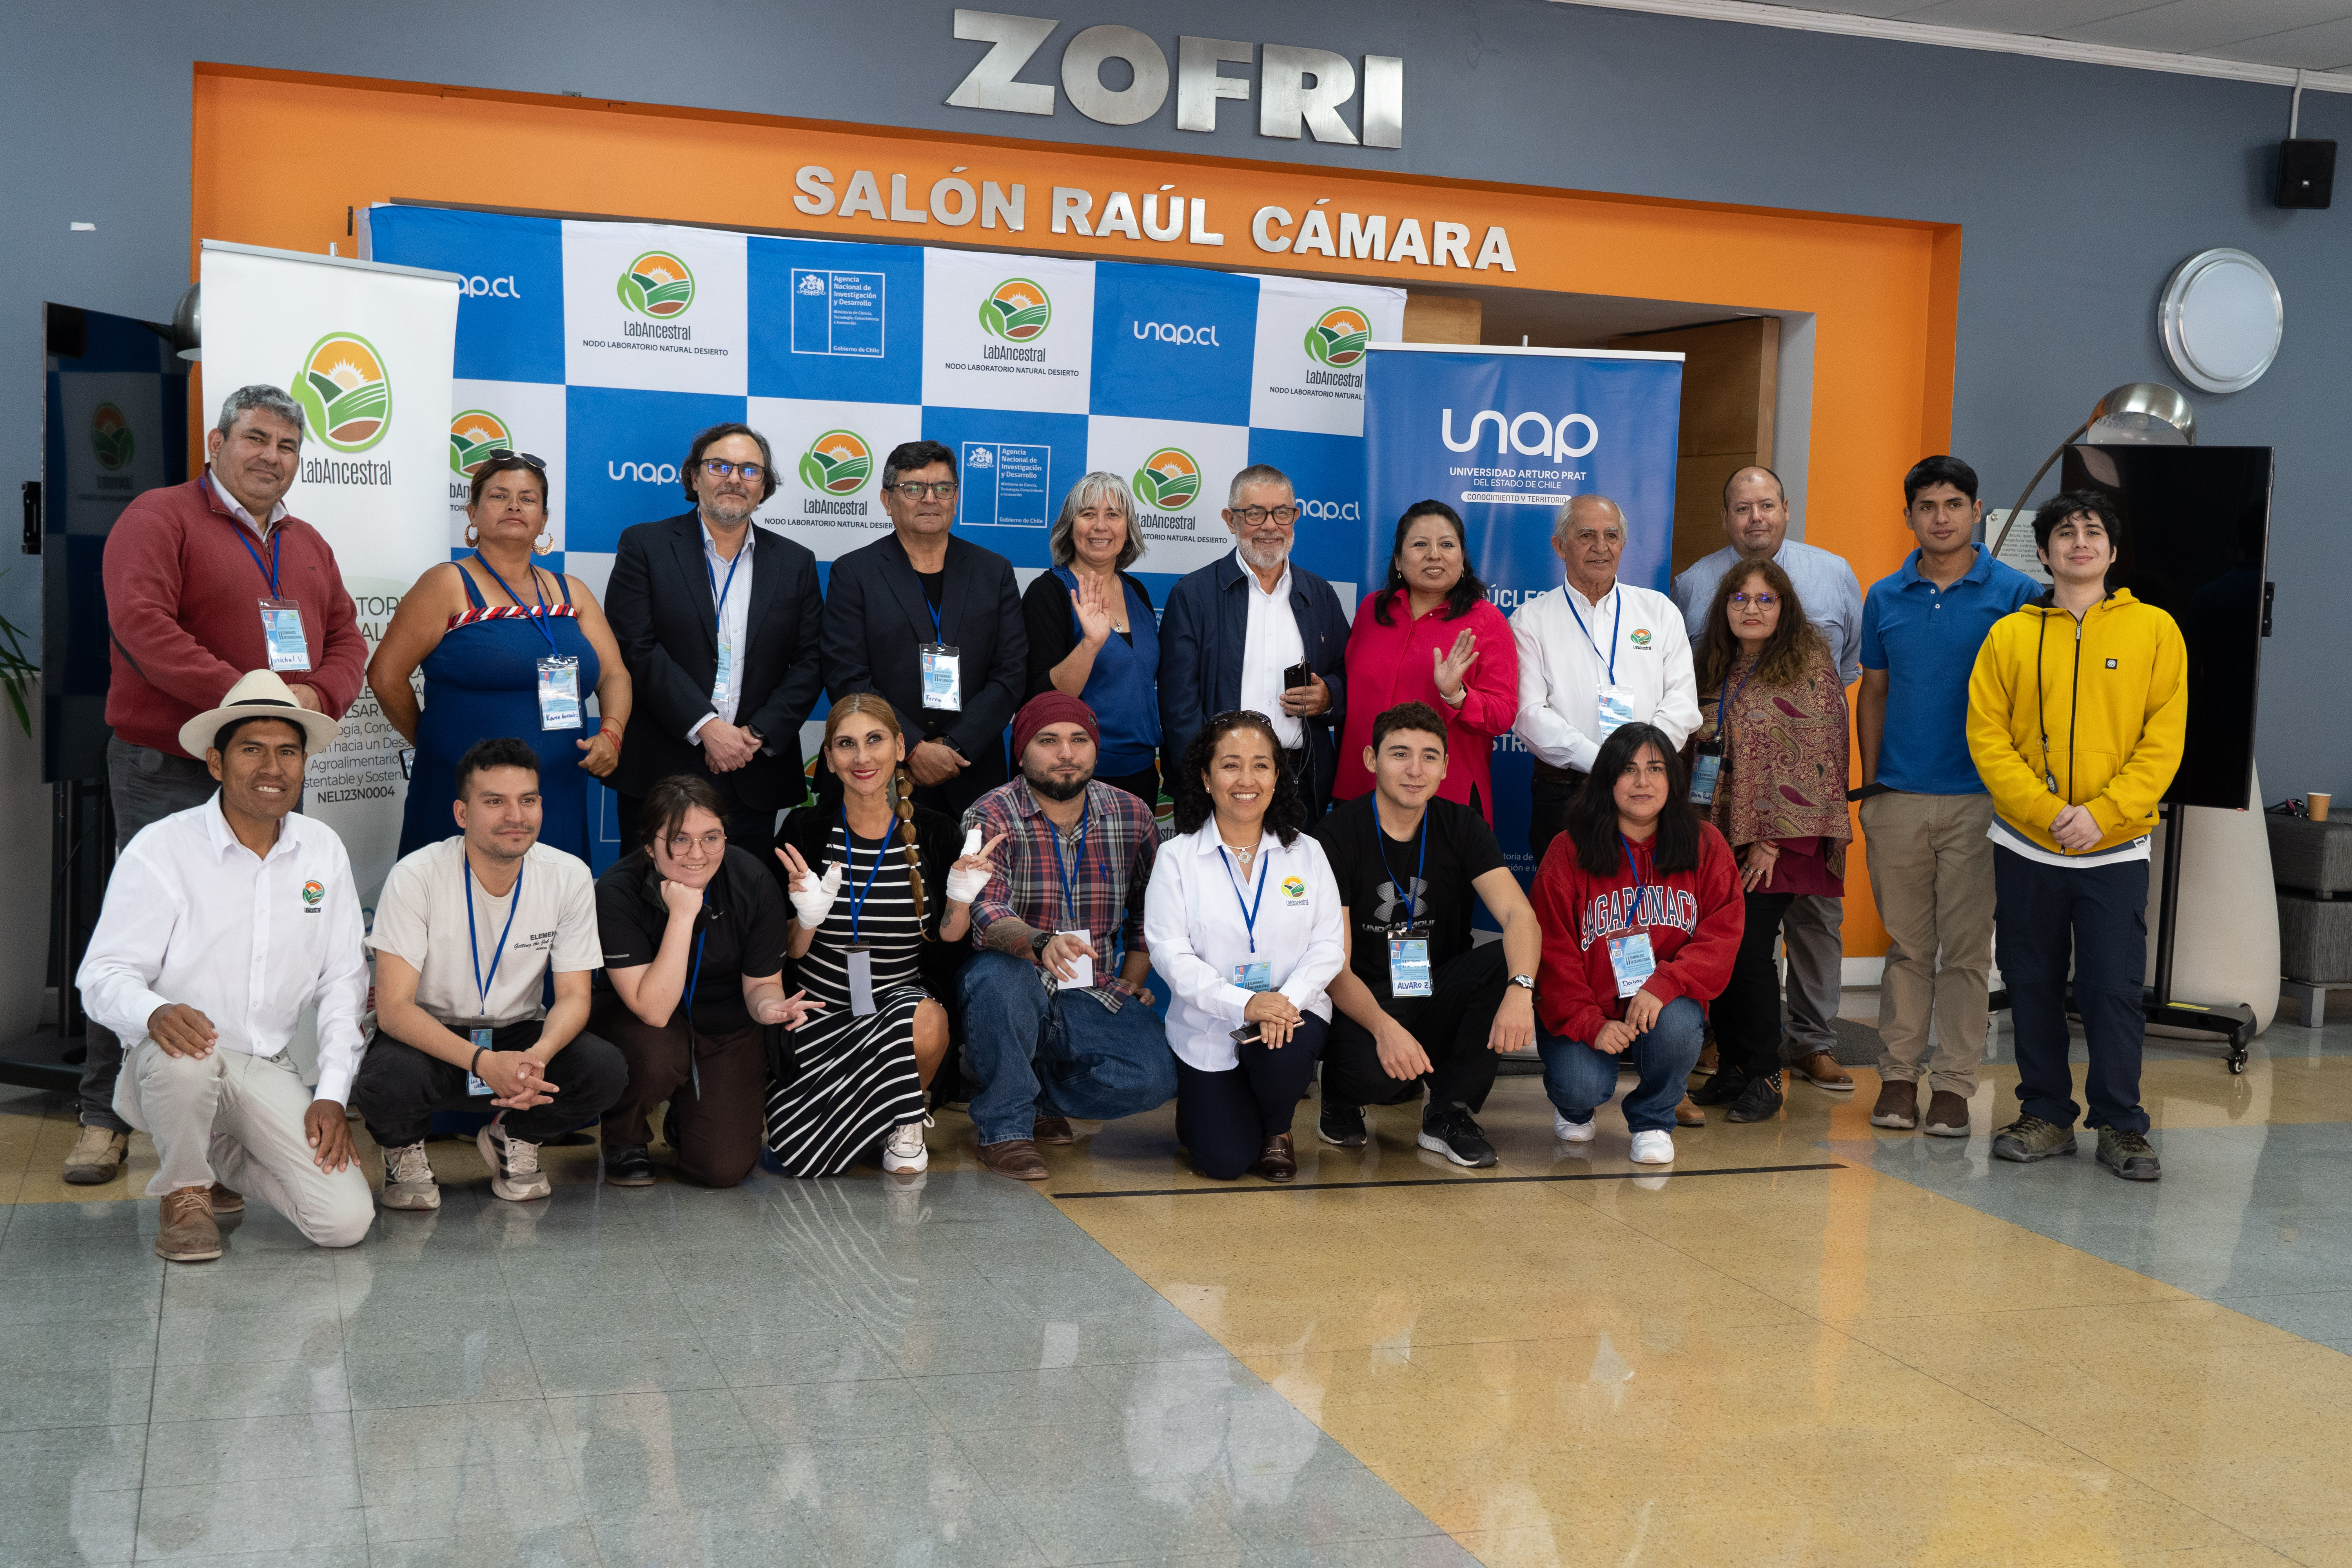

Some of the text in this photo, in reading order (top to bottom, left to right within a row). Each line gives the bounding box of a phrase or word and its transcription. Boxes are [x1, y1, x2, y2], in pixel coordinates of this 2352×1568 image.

[942, 8, 1403, 149] ZOFRI
[792, 165, 1516, 272] SALÓN RAÚL CÁMARA
[459, 276, 521, 299] ap.cl
[624, 321, 691, 340] LabAncestral
[1134, 321, 1219, 347] unap.cl
[608, 341, 658, 351] LABORATORIO
[984, 345, 1045, 362] LabAncestral
[967, 364, 1014, 372] LABORATORIO
[1306, 370, 1363, 388] LabAncestral
[1290, 388, 1333, 397] LABORATORIO
[1442, 408, 1598, 463] unap
[301, 457, 391, 485] LabAncestral
[609, 461, 681, 485] unap.
[1450, 467, 1586, 480] UNIVERSIDAD ARTURO PRAT
[1467, 494, 1519, 502] CONOCIMIENTO
[804, 499, 867, 515] LabAncestral
[1296, 498, 1360, 521] nap.cl
[335, 739, 363, 752] hacia
[366, 740, 380, 750] un
[311, 753, 399, 773] Agroalimentario
[304, 773, 355, 788] stentable
[357, 775, 364, 786] y
[318, 786, 396, 803] NEL123N0004
[530, 930, 556, 940] ELEMEN
